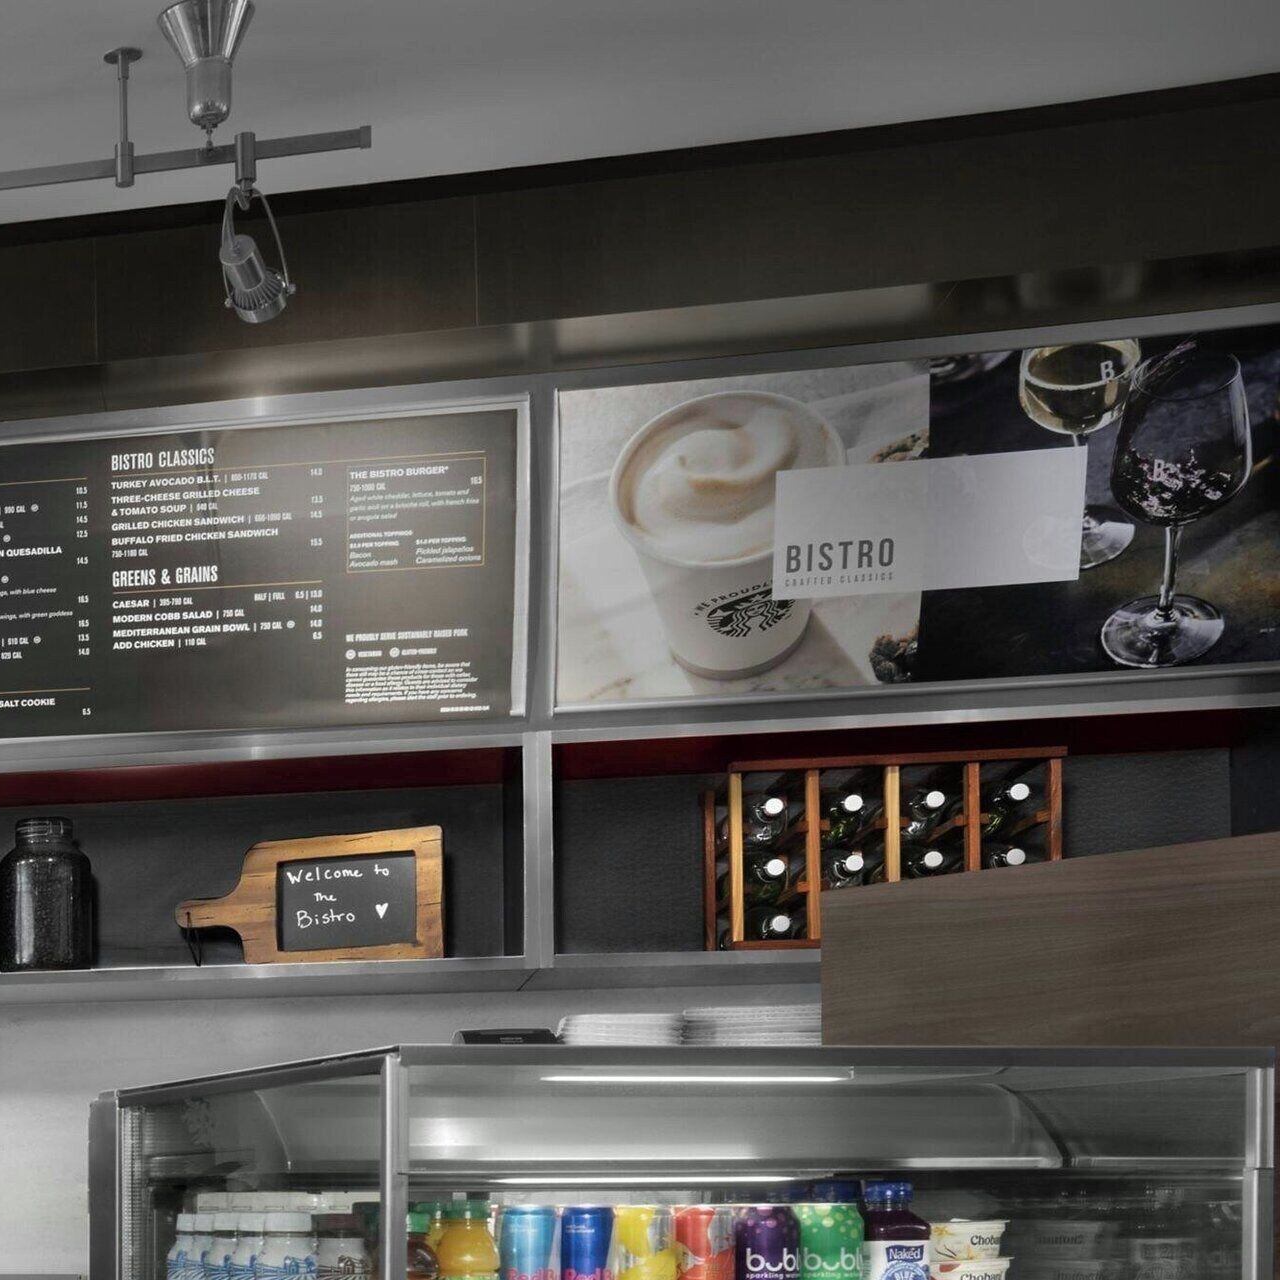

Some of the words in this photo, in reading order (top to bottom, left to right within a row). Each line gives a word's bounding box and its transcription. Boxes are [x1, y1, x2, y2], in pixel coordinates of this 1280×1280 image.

[111, 452, 152, 470] BISTRO
[159, 448, 213, 467] CLASSICS
[350, 471, 367, 479] THE
[370, 468, 404, 478] BISTRO
[111, 480, 147, 489] TURKEY
[149, 476, 194, 486] AVOCADO
[196, 475, 220, 483] B.L.T.
[111, 492, 180, 503] THREE-CHEESE
[182, 490, 220, 499] GRILLED
[222, 487, 259, 496] CHEESE
[119, 506, 158, 515] TOMATO
[160, 504, 186, 512] SOUP
[112, 521, 149, 530] GRILLED
[151, 518, 192, 528] CHICKEN
[194, 515, 244, 525] SANDWICH
[112, 535, 153, 545] BUFFALO
[155, 534, 182, 542] FRIED
[184, 531, 225, 540] CHICKEN
[227, 528, 278, 538] SANDWICH
[6, 546, 61, 556] QUESADILLA
[786, 538, 894, 573] BISTRO
[112, 569, 155, 586] GREENS
[161, 569, 170, 584] &
[176, 565, 217, 583] GRAINS
[785, 577, 832, 587] CRAFTED
[839, 572, 894, 584] CLASSICS
[112, 599, 149, 608] CAESAR
[113, 614, 152, 622] MODERN
[154, 612, 180, 620] COBB
[182, 611, 212, 619] SALAD
[113, 626, 190, 636] MEDITERRANEAN
[192, 625, 220, 633] GRAIN
[222, 623, 249, 631] BOWL
[113, 641, 132, 649] ADD
[134, 639, 174, 648] CHICKEN
[21, 698, 55, 706] COOKIE
[286, 867, 363, 884] Welcome
[374, 864, 390, 876] to
[296, 909, 357, 929] Bistro
[889, 1248, 921, 1259] Naked
[746, 1272, 784, 1280] sparkling
